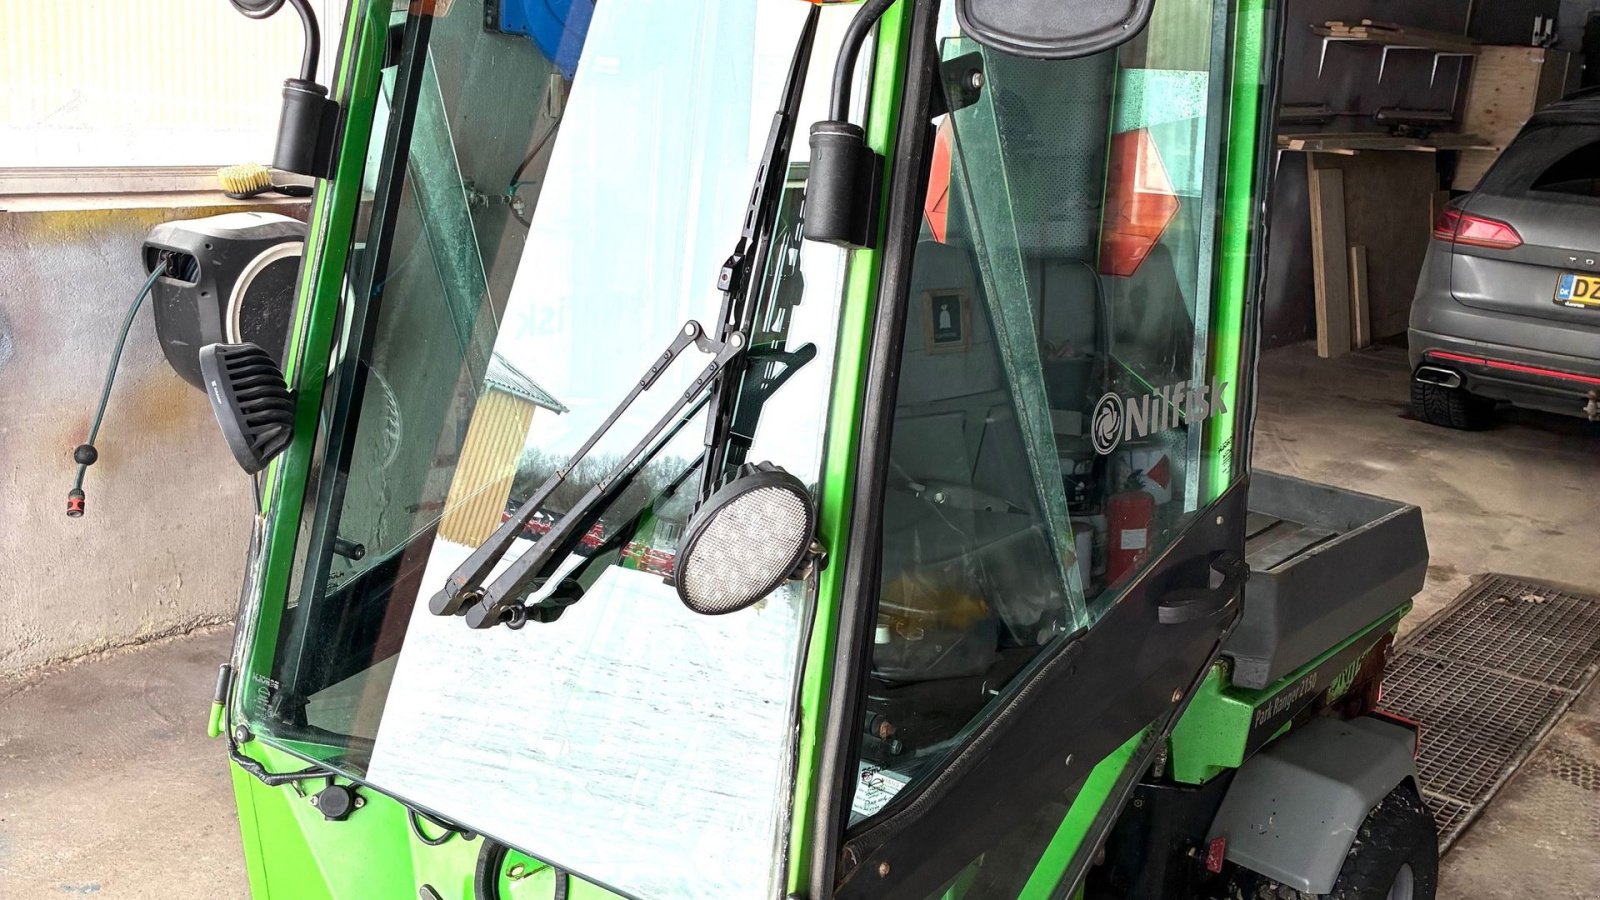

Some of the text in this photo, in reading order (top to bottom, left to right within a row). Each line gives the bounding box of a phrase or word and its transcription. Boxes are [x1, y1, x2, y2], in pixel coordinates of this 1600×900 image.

[1125, 375, 1229, 441] Nilfisk
[1255, 672, 1317, 728] Park Ranger 2150
